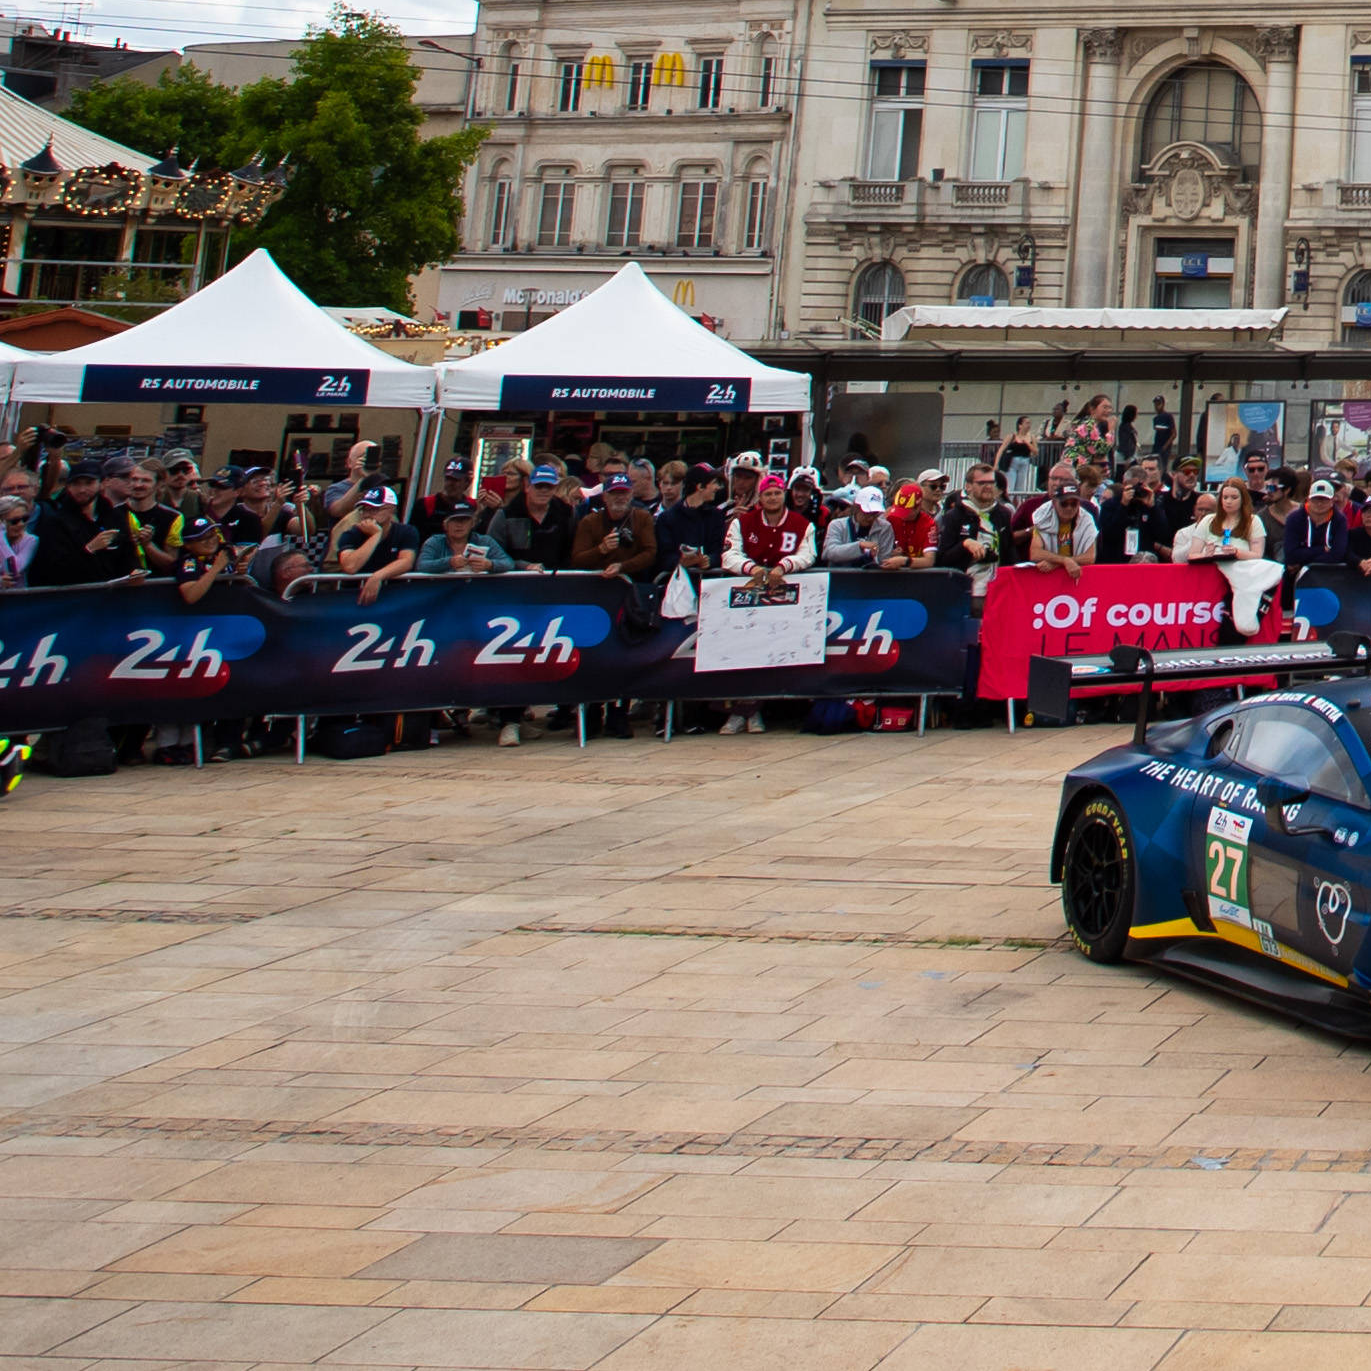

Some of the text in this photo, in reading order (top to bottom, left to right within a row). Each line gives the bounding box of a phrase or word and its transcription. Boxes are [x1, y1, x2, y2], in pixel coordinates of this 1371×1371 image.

[140, 377, 161, 390] RS
[163, 377, 261, 391] AUTOMOBILE
[551, 387, 570, 399] RS
[571, 387, 657, 399] AUTOMOBILE
[779, 532, 797, 552] B
[0, 632, 70, 688] 4h
[1139, 759, 1302, 822] THE HEART OF RANG
[1208, 840, 1243, 901] 27
